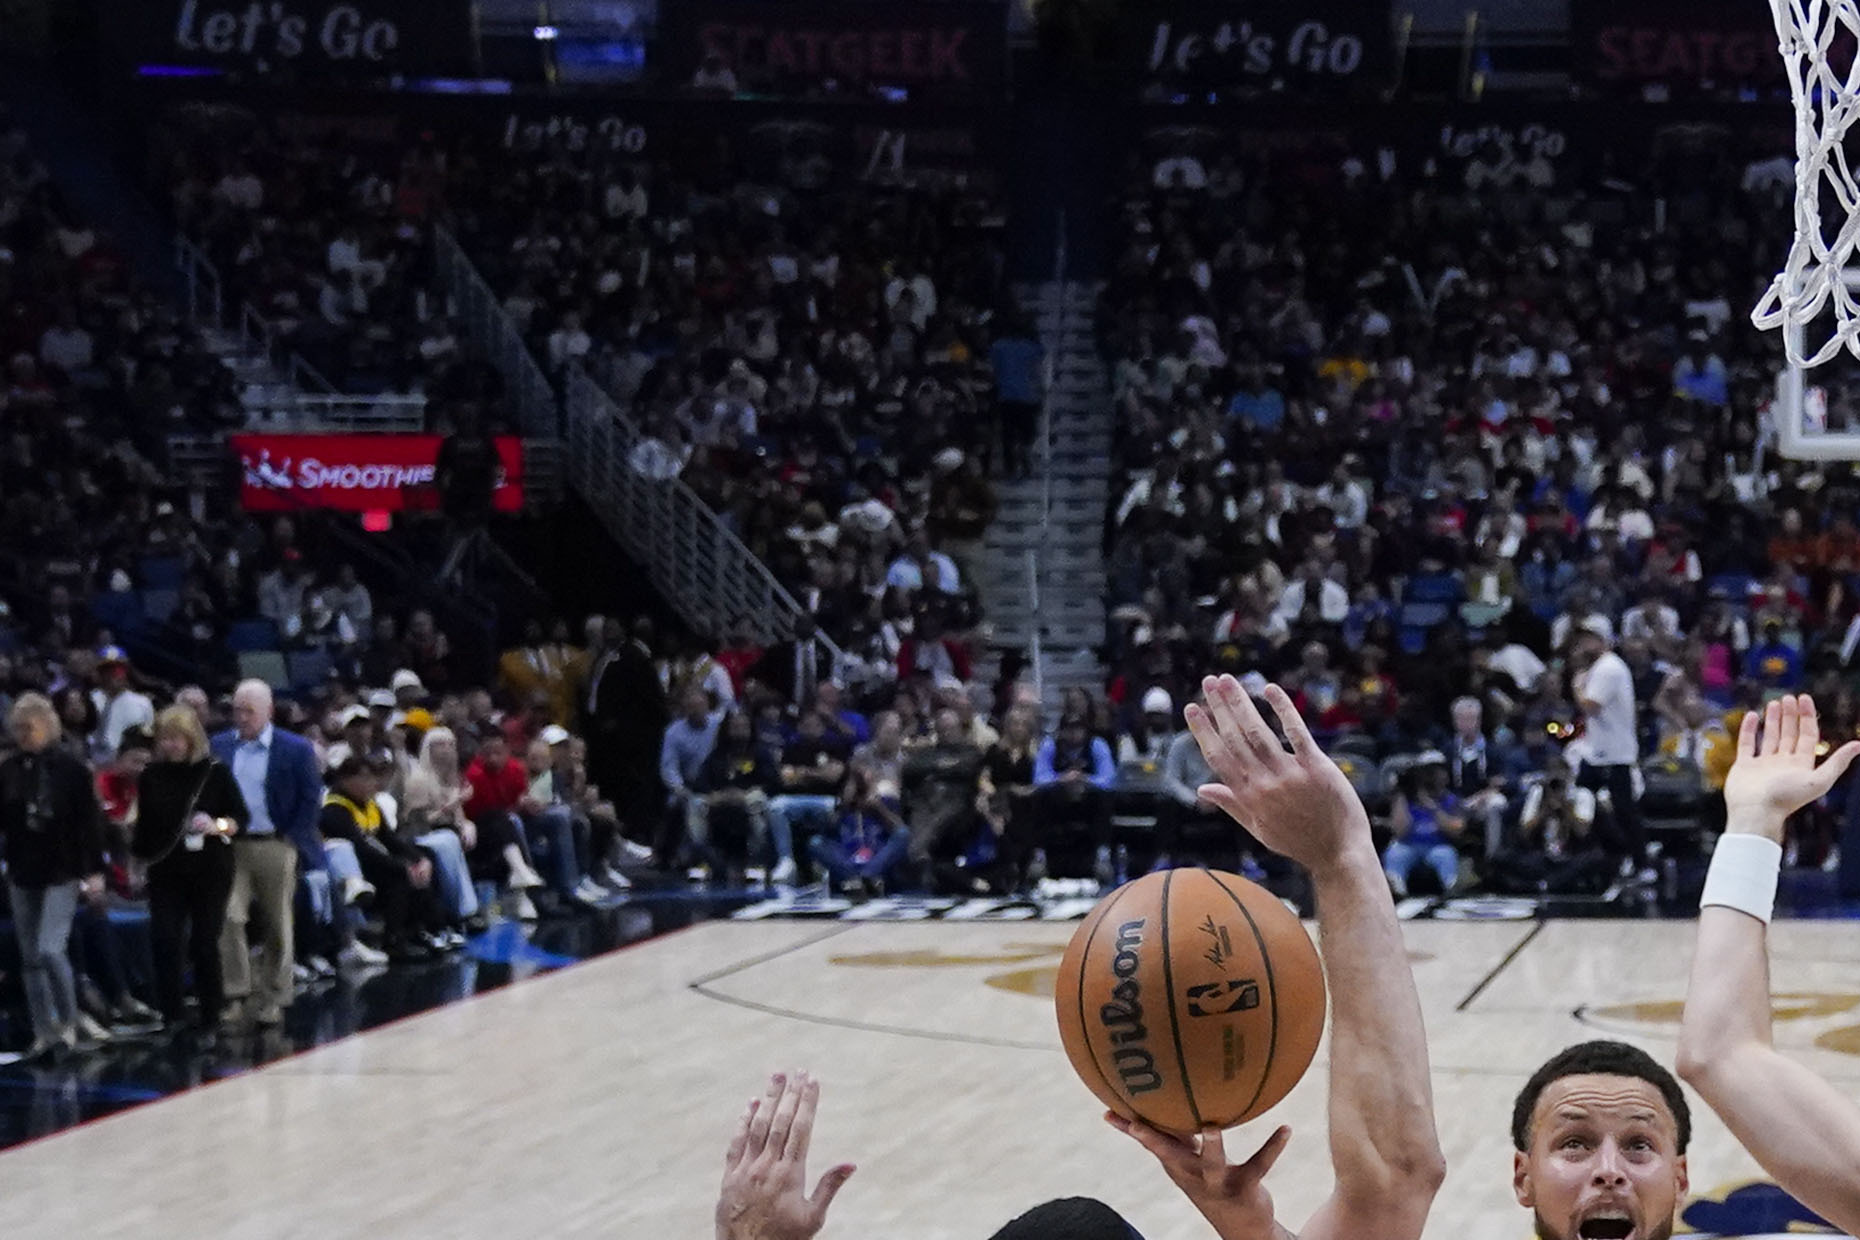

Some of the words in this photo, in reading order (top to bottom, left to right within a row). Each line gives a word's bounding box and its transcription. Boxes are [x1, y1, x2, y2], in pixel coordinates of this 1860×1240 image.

[174, 0, 304, 58] Let's
[320, 4, 398, 61] Go
[1287, 19, 1363, 76] Go
[1100, 918, 1163, 1096] Wilson
